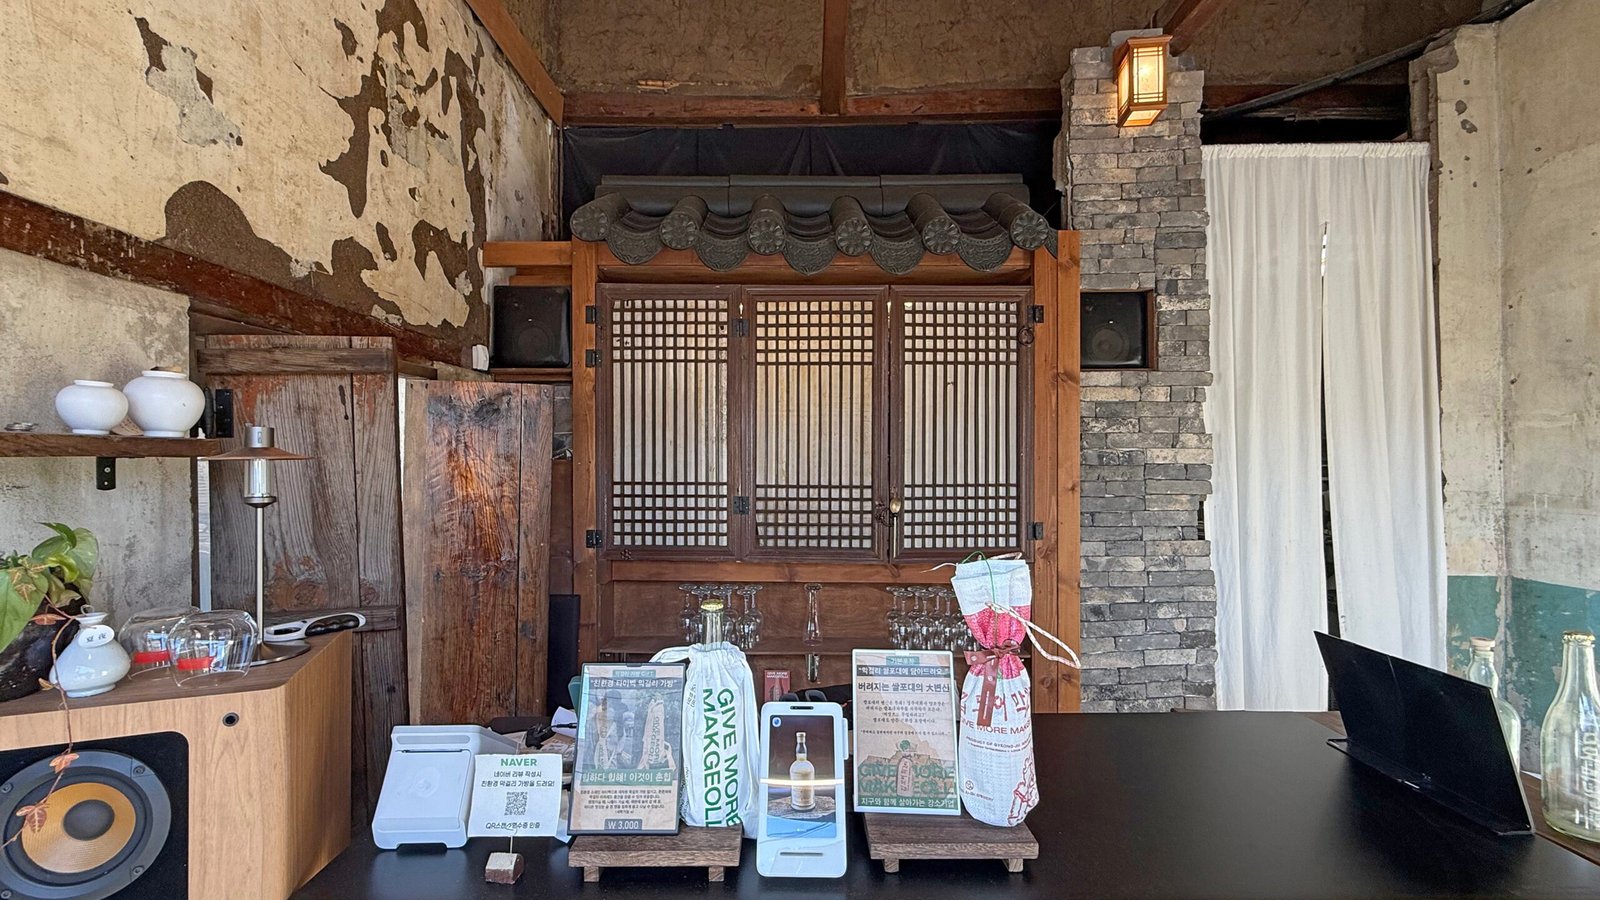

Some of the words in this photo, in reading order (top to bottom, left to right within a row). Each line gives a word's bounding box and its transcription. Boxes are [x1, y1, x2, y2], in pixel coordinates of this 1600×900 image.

[858, 682, 889, 691] 버려지는
[892, 683, 923, 692] 쌀포대의
[926, 684, 950, 692] 大변신
[717, 688, 737, 750] GIVE
[630, 772, 652, 782] 이것이
[725, 754, 742, 828] MORE
